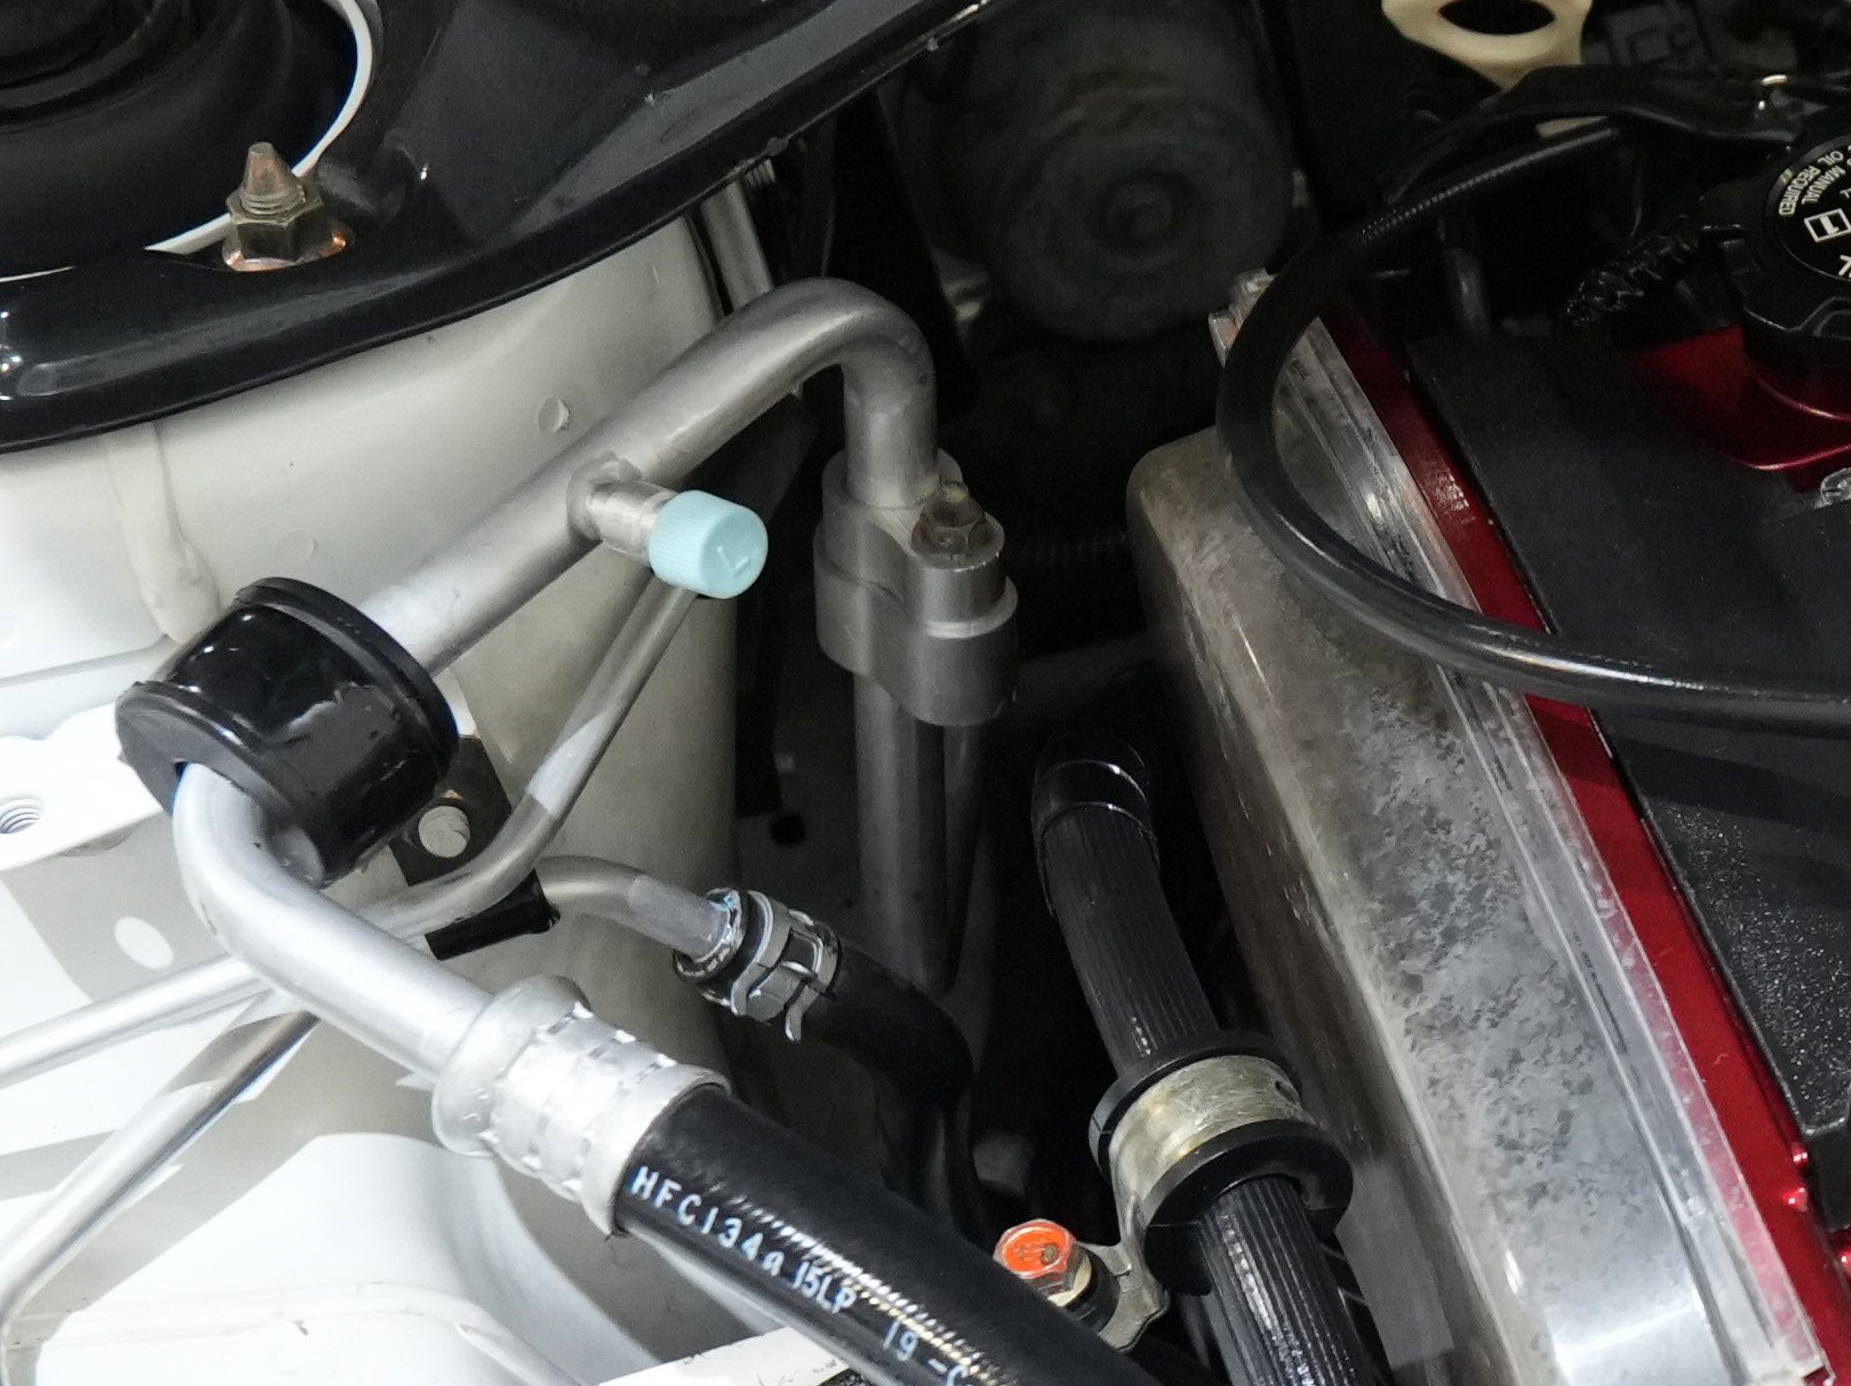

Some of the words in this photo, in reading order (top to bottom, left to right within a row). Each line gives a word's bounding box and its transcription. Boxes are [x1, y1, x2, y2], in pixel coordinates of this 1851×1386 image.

[1817, 149, 1845, 166] OIL
[1778, 164, 1822, 216] REQUIRED
[1800, 164, 1847, 205] MANUAL
